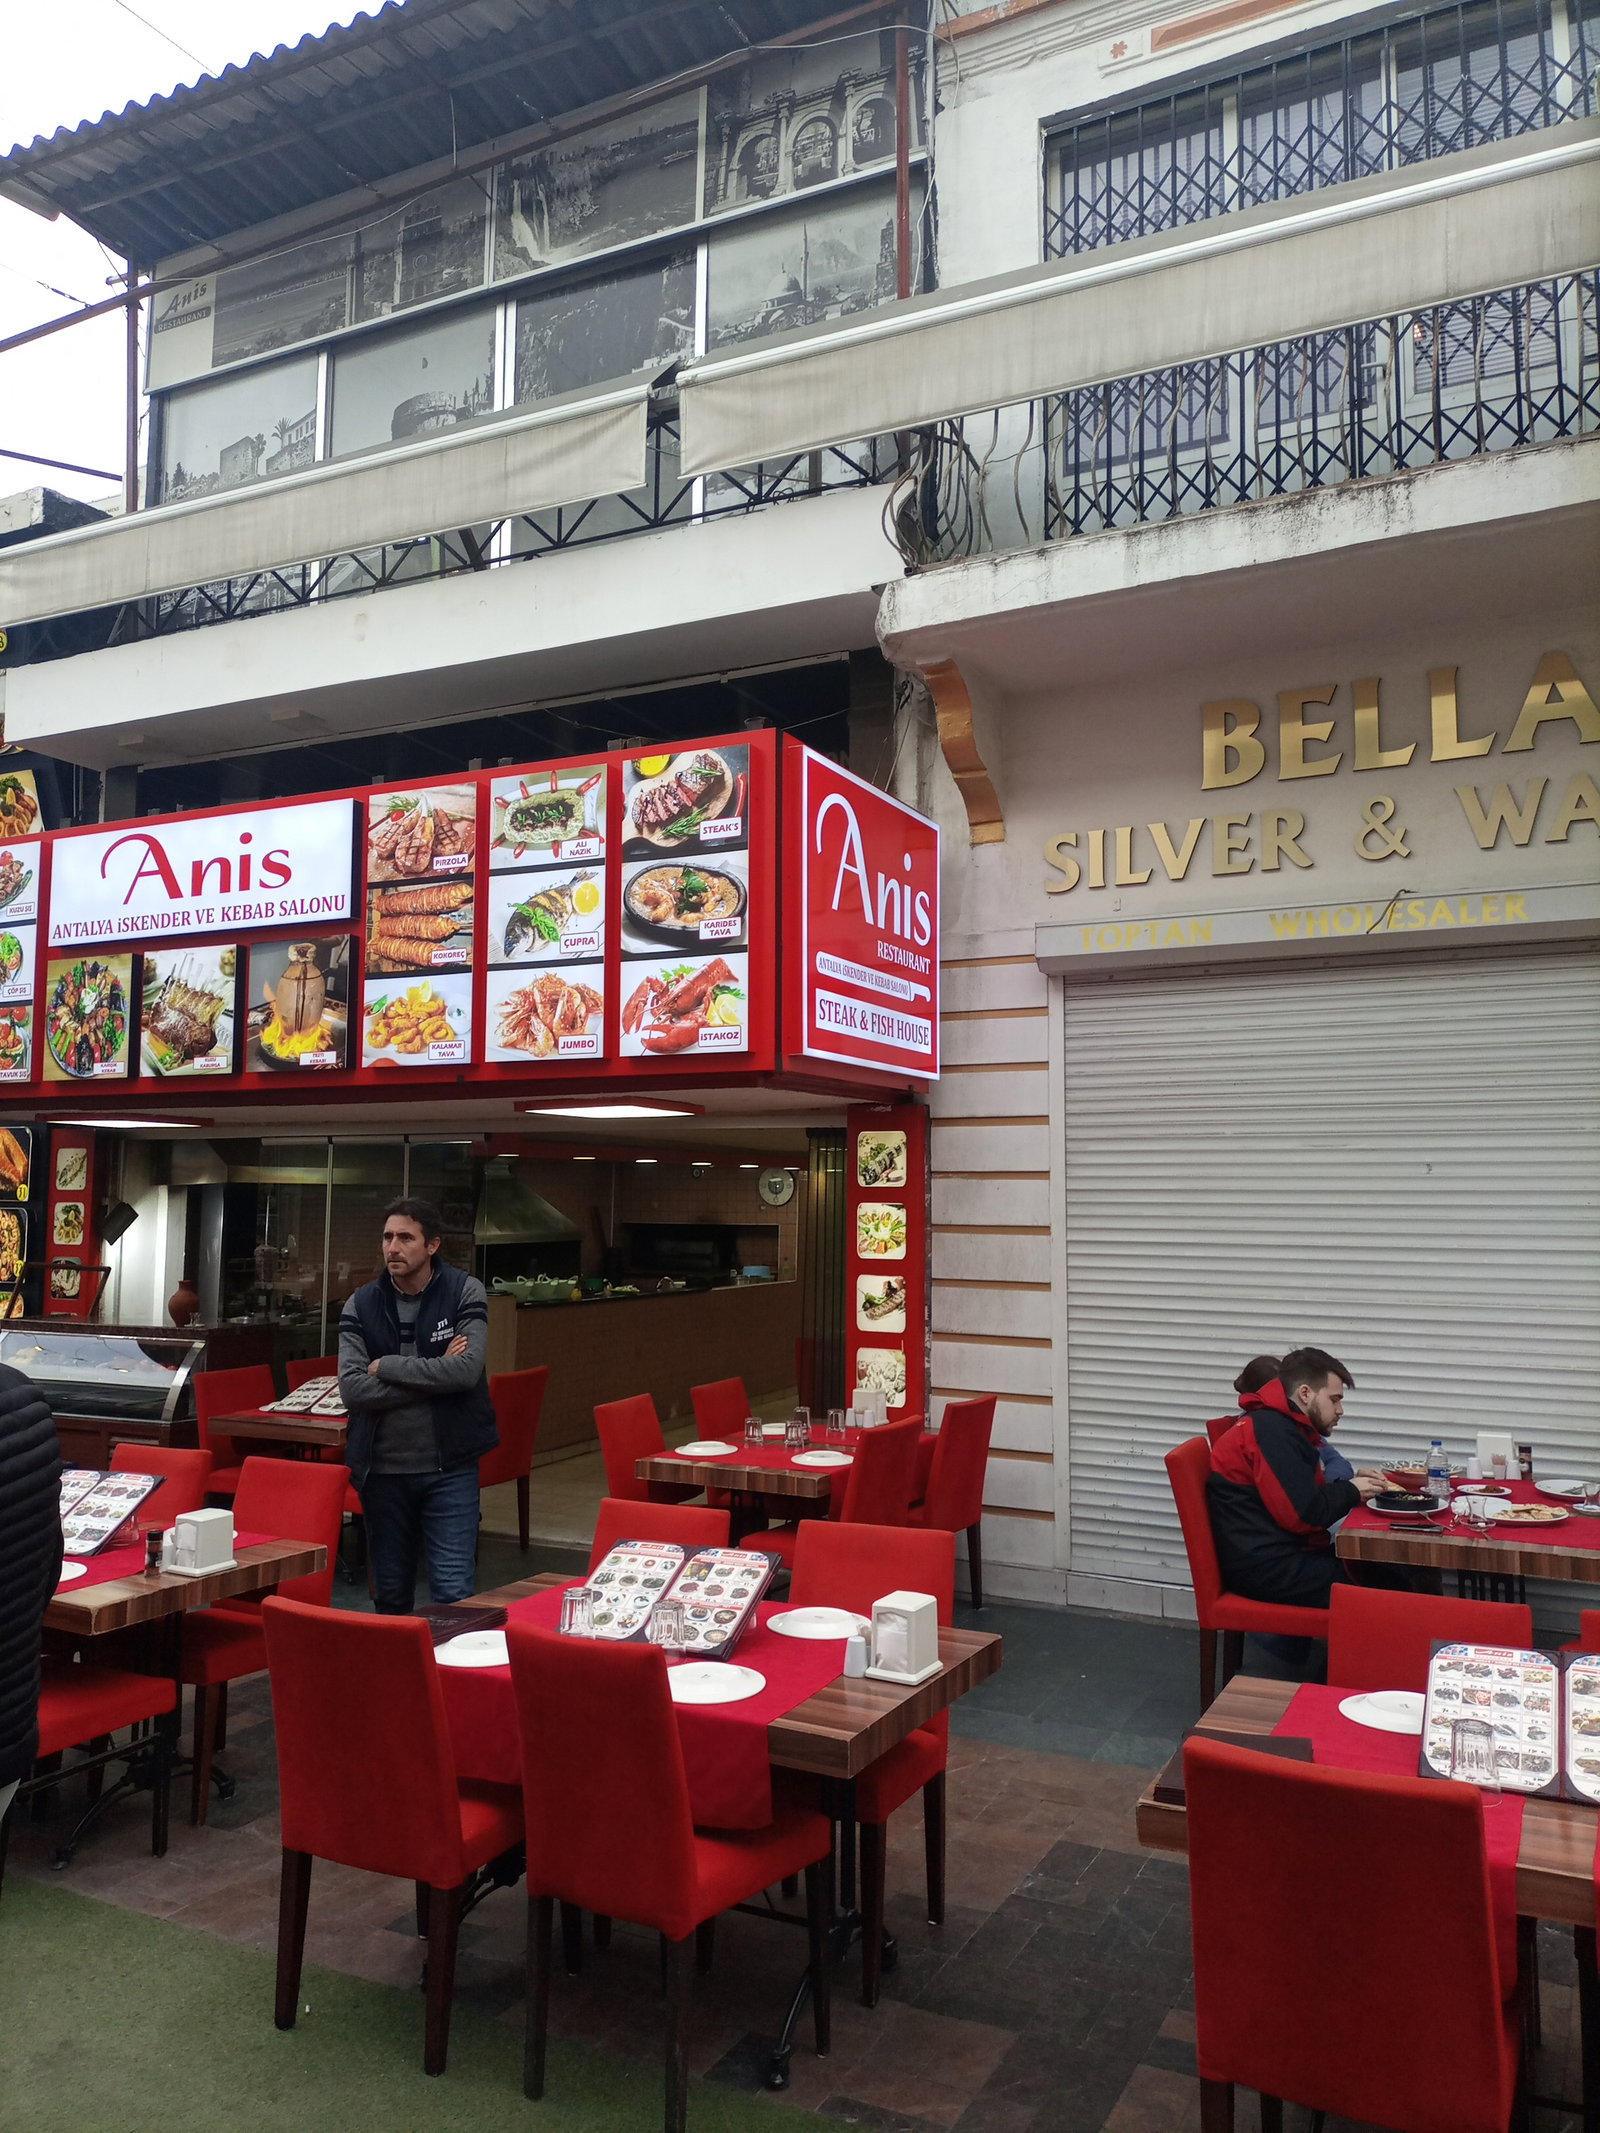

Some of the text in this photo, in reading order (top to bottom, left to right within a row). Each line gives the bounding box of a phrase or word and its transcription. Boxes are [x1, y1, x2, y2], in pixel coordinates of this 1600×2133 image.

[157, 282, 207, 320] Anis
[158, 310, 208, 331] RESTAURANT
[1201, 649, 1600, 791] BELLA
[702, 822, 739, 836] STEAK'S
[1044, 808, 1314, 893] SILVER
[1353, 795, 1412, 863] &
[100, 831, 292, 905] Anis
[816, 792, 932, 947] Anis
[52, 918, 114, 940] ANTALYA
[195, 907, 215, 926] VE
[220, 902, 275, 923] KEBAB
[278, 894, 346, 917] SALONU
[709, 928, 732, 937] TAVA
[1079, 893, 1530, 953] TOPTAN WHOLESALER
[433, 950, 466, 961] KOKOREÇ
[563, 936, 595, 948] ÇUPRA
[877, 940, 931, 975] RESTAURANT
[818, 956, 842, 975] ANTALYA
[867, 972, 875, 985] VE
[874, 974, 891, 991] KEBAB
[891, 980, 909, 996] SALONU
[819, 998, 929, 1046] STEAK & FISH HOUSE
[431, 1043, 463, 1051] KALAMAR
[560, 1039, 595, 1050] JUMBO
